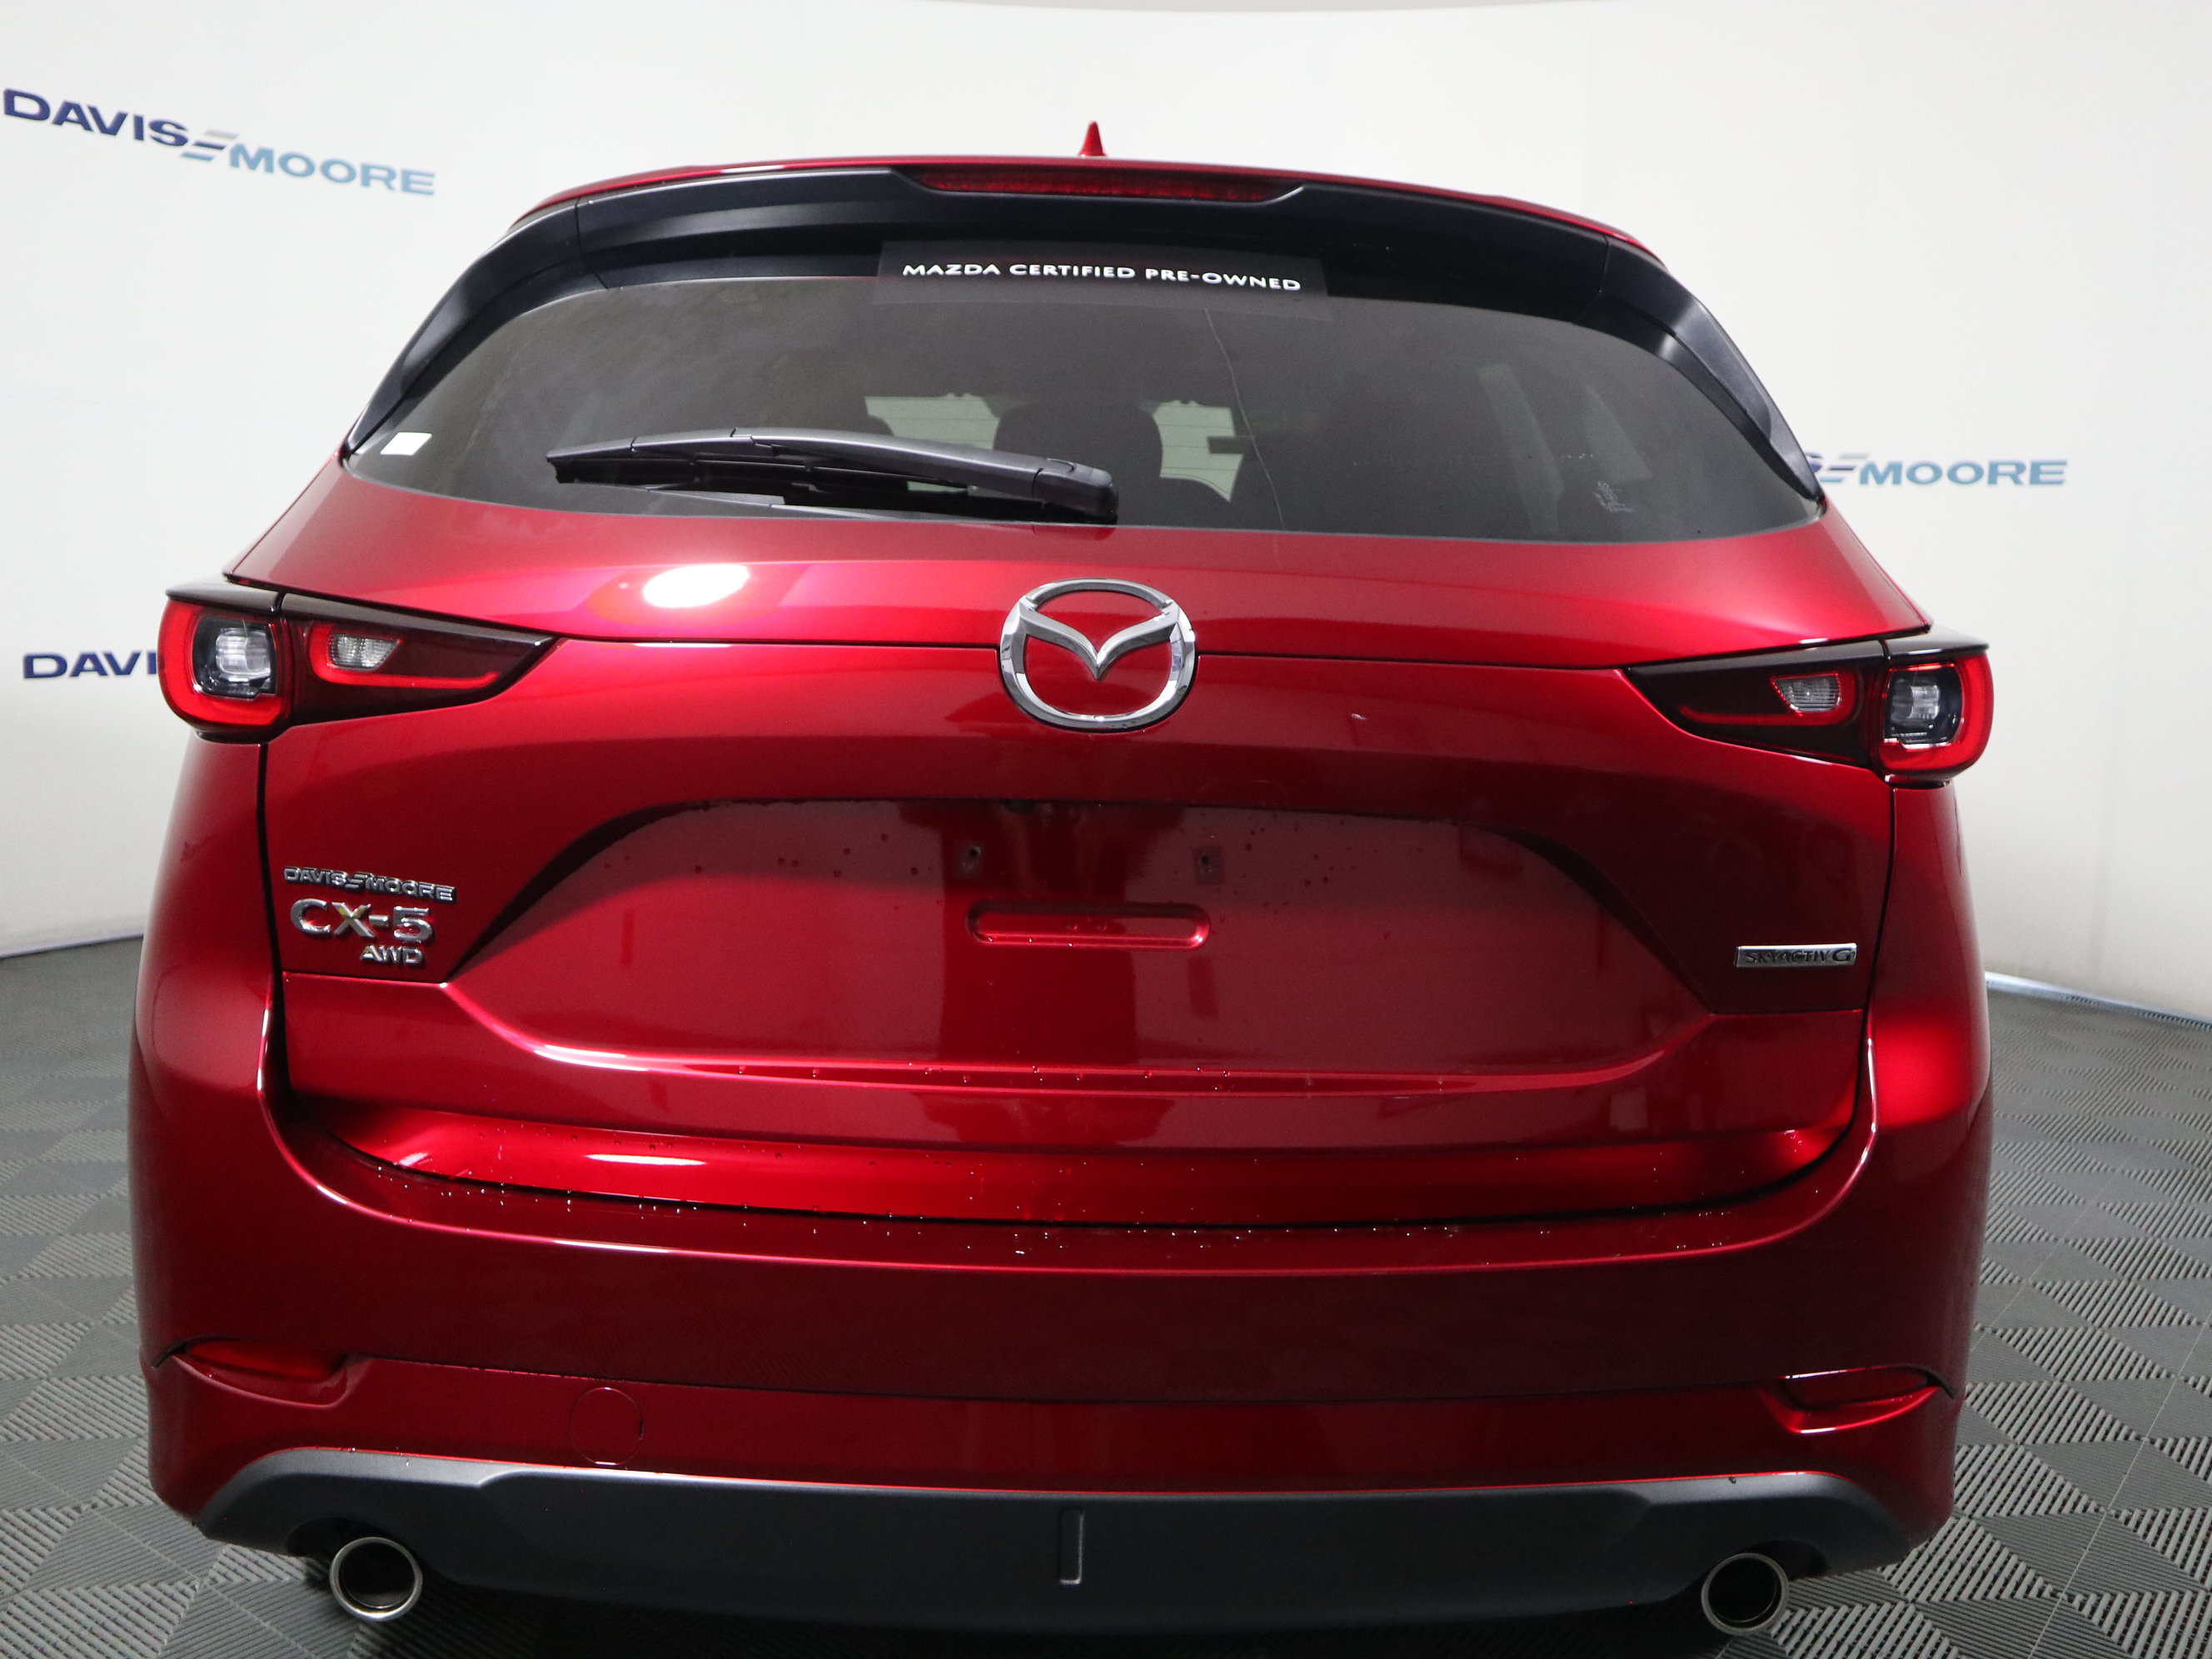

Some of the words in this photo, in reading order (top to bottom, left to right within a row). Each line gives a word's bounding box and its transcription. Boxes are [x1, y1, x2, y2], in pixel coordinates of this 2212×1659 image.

[229, 143, 436, 196] MOORE
[903, 263, 1000, 276] MAZDA
[1009, 263, 1135, 278] CERTIFIED
[1146, 268, 1301, 291] PRE-OWNED
[1859, 460, 2068, 486] MOORE
[22, 650, 157, 679] DAVI
[290, 898, 434, 944] CX-5
[360, 944, 426, 965] AWD
[1745, 949, 1829, 964] SKYACTIV
